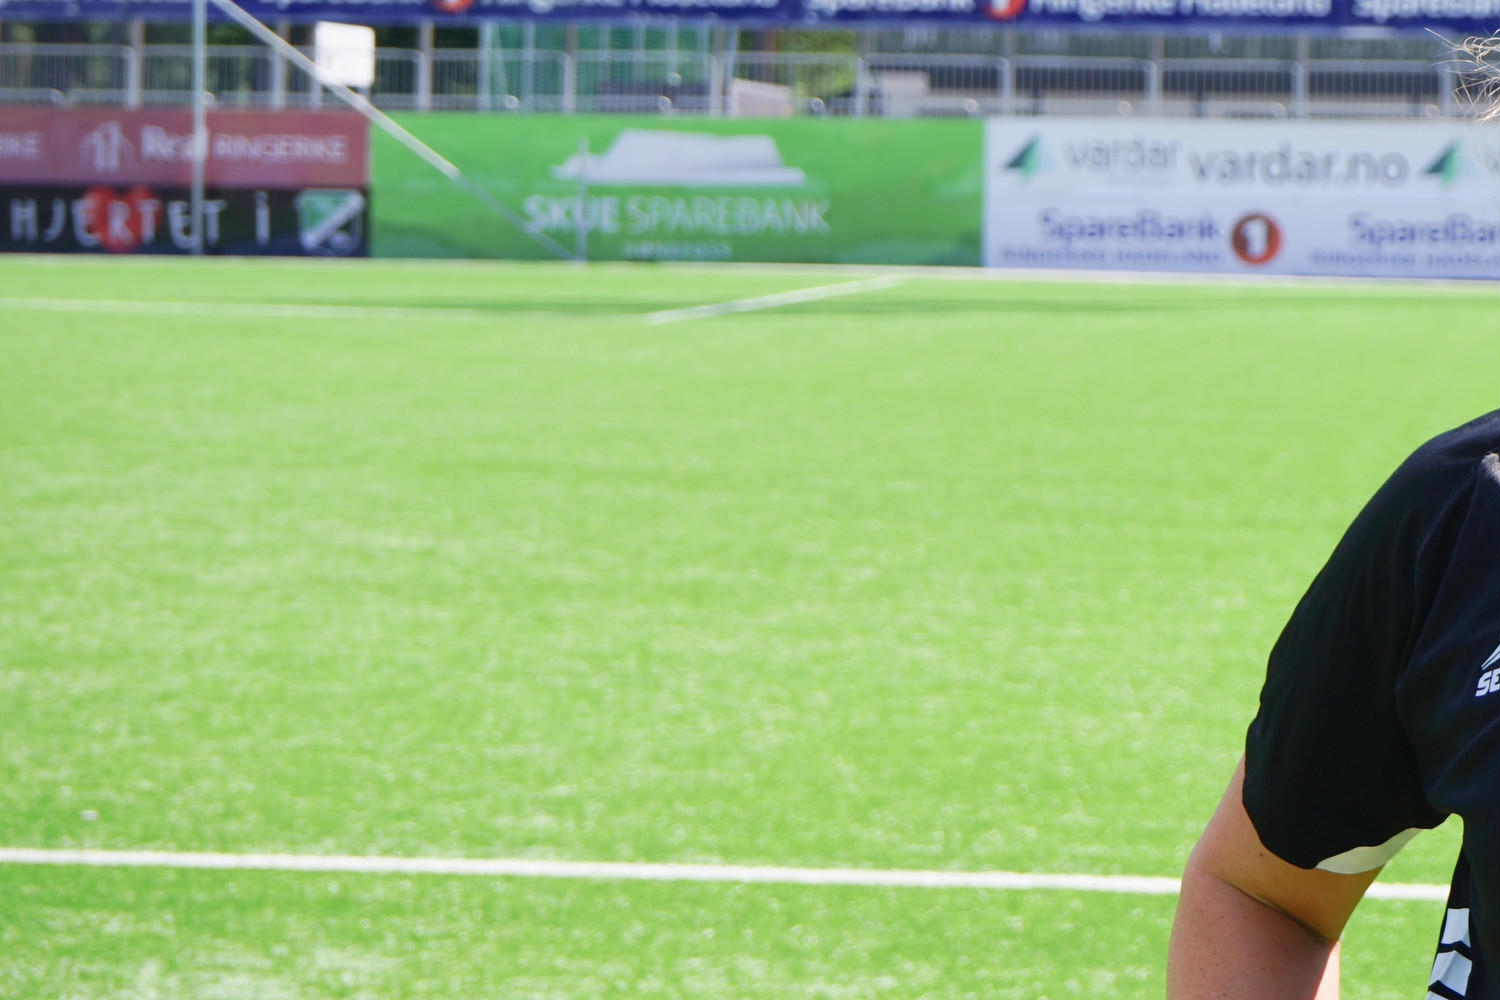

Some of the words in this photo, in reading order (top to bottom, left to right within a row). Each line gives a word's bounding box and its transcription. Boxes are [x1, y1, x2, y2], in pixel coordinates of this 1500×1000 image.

[1062, 136, 1181, 171] vardar
[1189, 140, 1410, 185] vardar.no
[10, 198, 226, 248] HJERTET
[522, 195, 620, 233] SKUE
[624, 195, 830, 235] SPAREBANK
[1039, 208, 1222, 243] SpareBank
